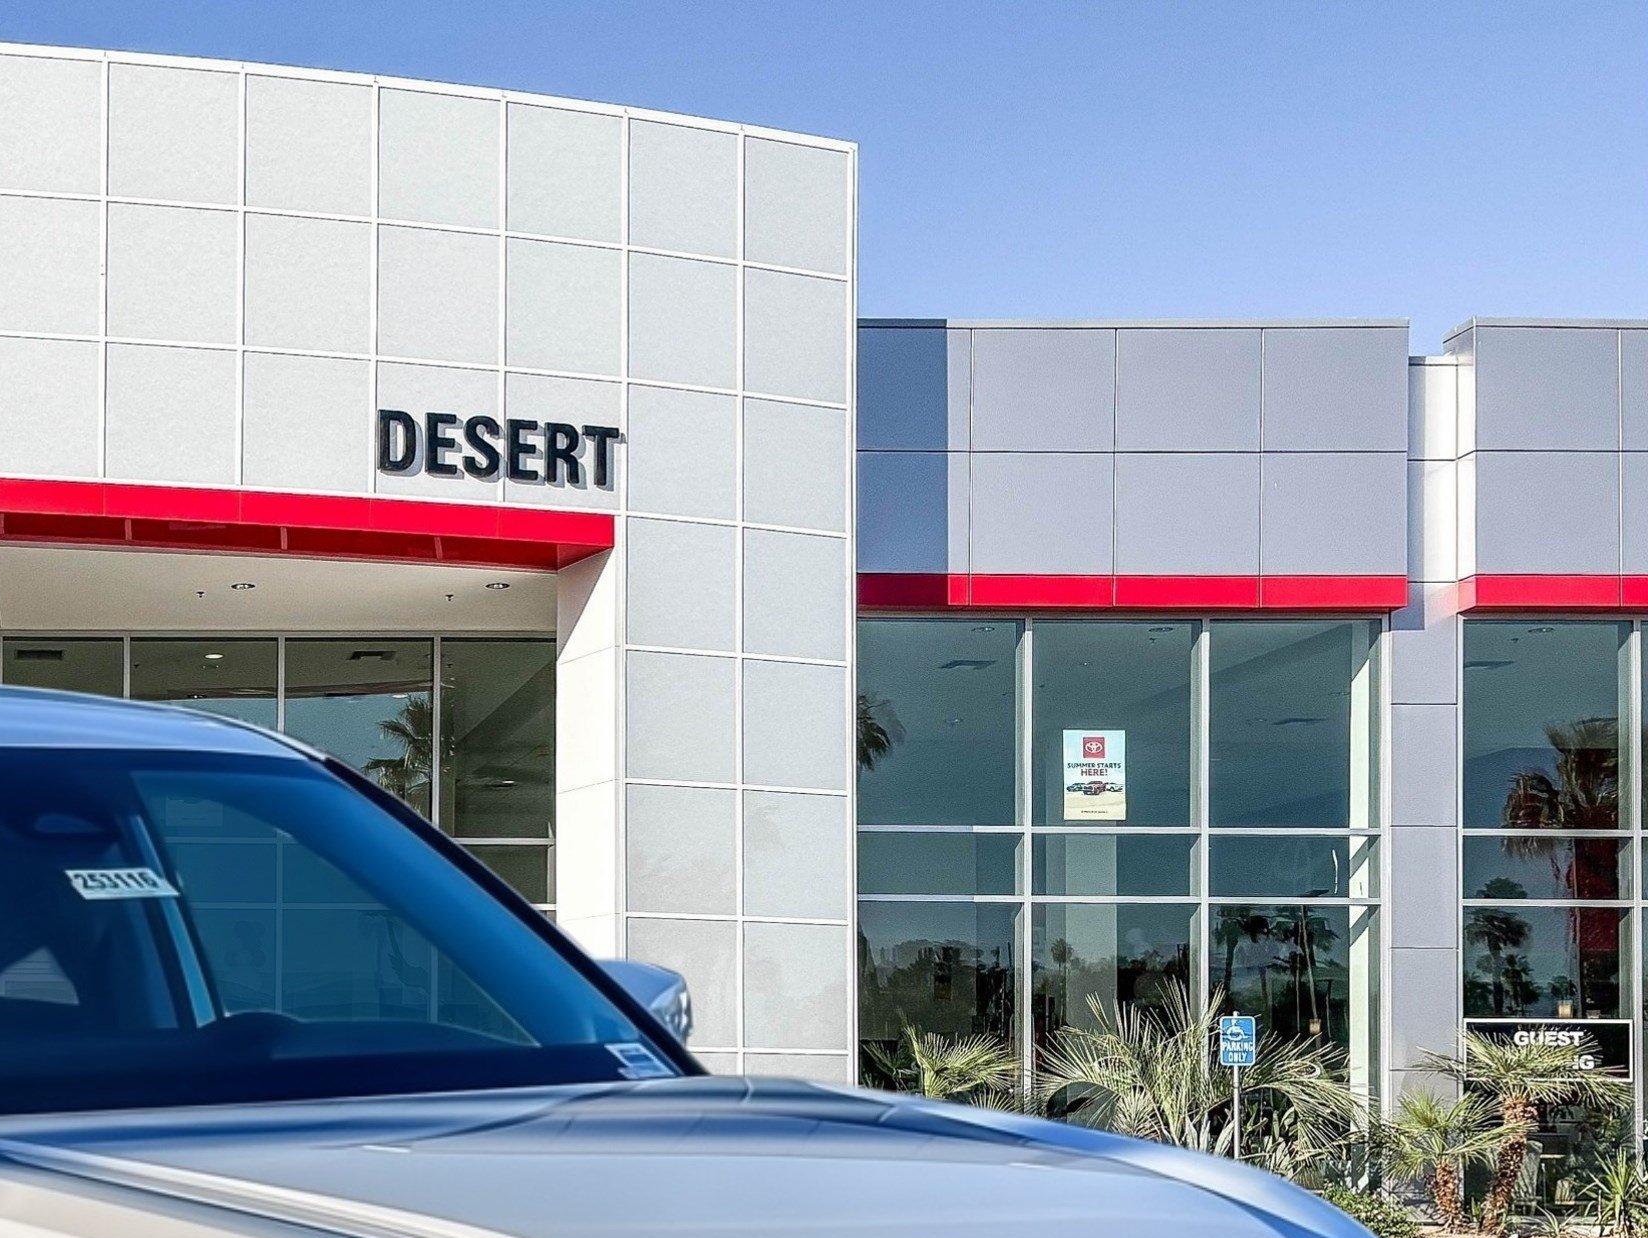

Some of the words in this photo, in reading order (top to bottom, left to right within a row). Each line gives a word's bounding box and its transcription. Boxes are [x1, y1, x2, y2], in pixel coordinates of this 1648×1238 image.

[377, 409, 620, 487] DESERT
[1513, 1030, 1584, 1046] GUEST
[1223, 1041, 1253, 1052] PARKING
[1228, 1052, 1247, 1062] ONLY
